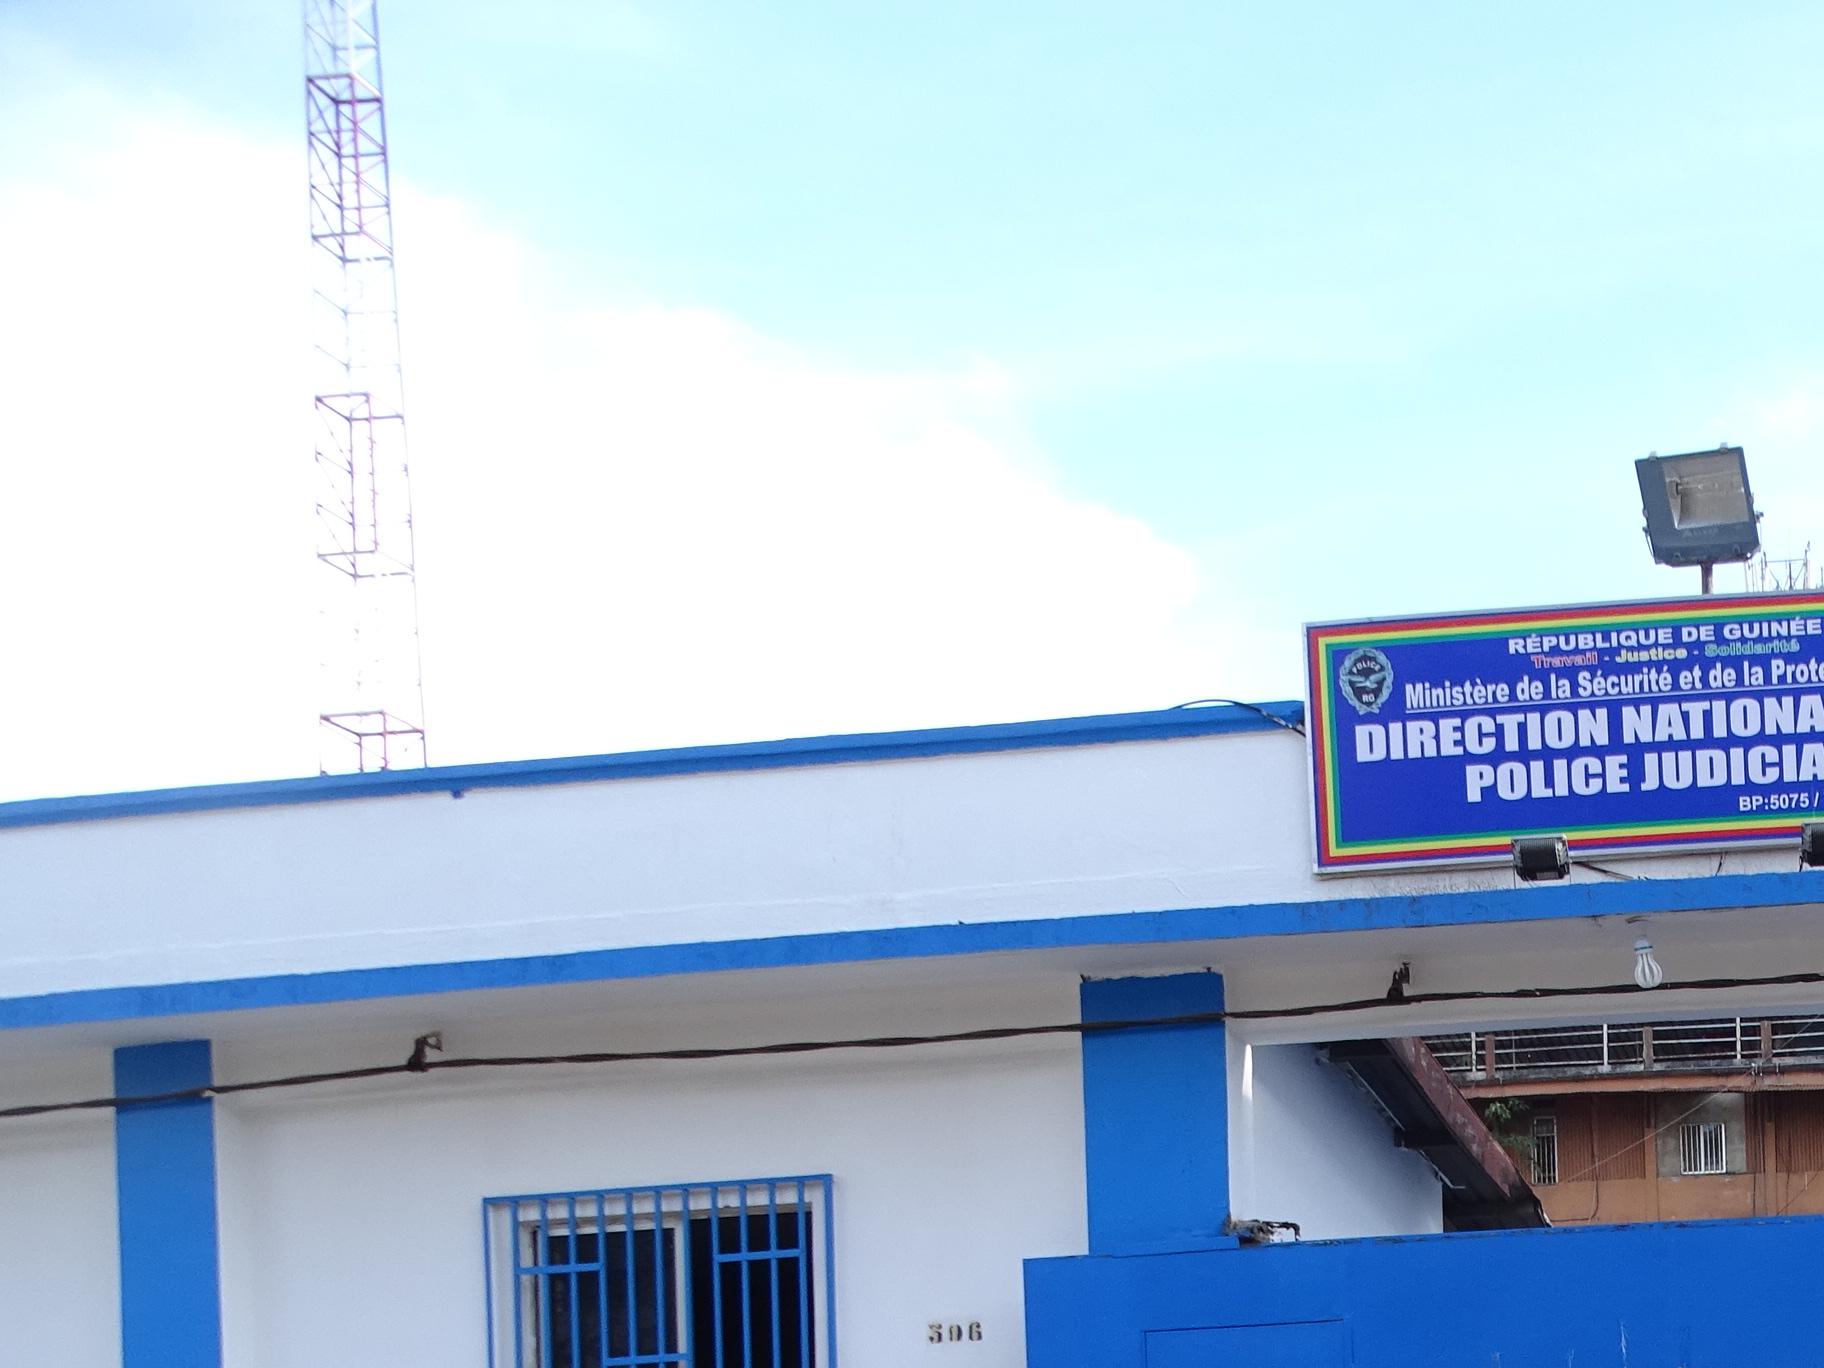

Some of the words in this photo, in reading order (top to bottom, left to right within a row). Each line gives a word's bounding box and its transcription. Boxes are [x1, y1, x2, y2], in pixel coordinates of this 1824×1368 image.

[1508, 627, 1674, 655] RÉPUBLIQUE
[1682, 624, 1715, 643] DE
[1723, 617, 1823, 641] GUINÉE
[1531, 652, 1598, 669] Travail
[1615, 647, 1688, 663] Justice
[1704, 637, 1800, 658] Solidarité
[1352, 660, 1381, 674] POLICE
[1405, 677, 1510, 708] Ministère
[1516, 675, 1543, 702] de
[1551, 673, 1571, 700] la
[1578, 666, 1673, 697] Sécurité
[1679, 666, 1703, 690] et
[1709, 661, 1737, 689] de
[1743, 660, 1765, 687] la
[1354, 707, 1609, 763] DIRECTION
[1465, 754, 1630, 803] POLICE
[1738, 792, 1810, 812] BP:5075
